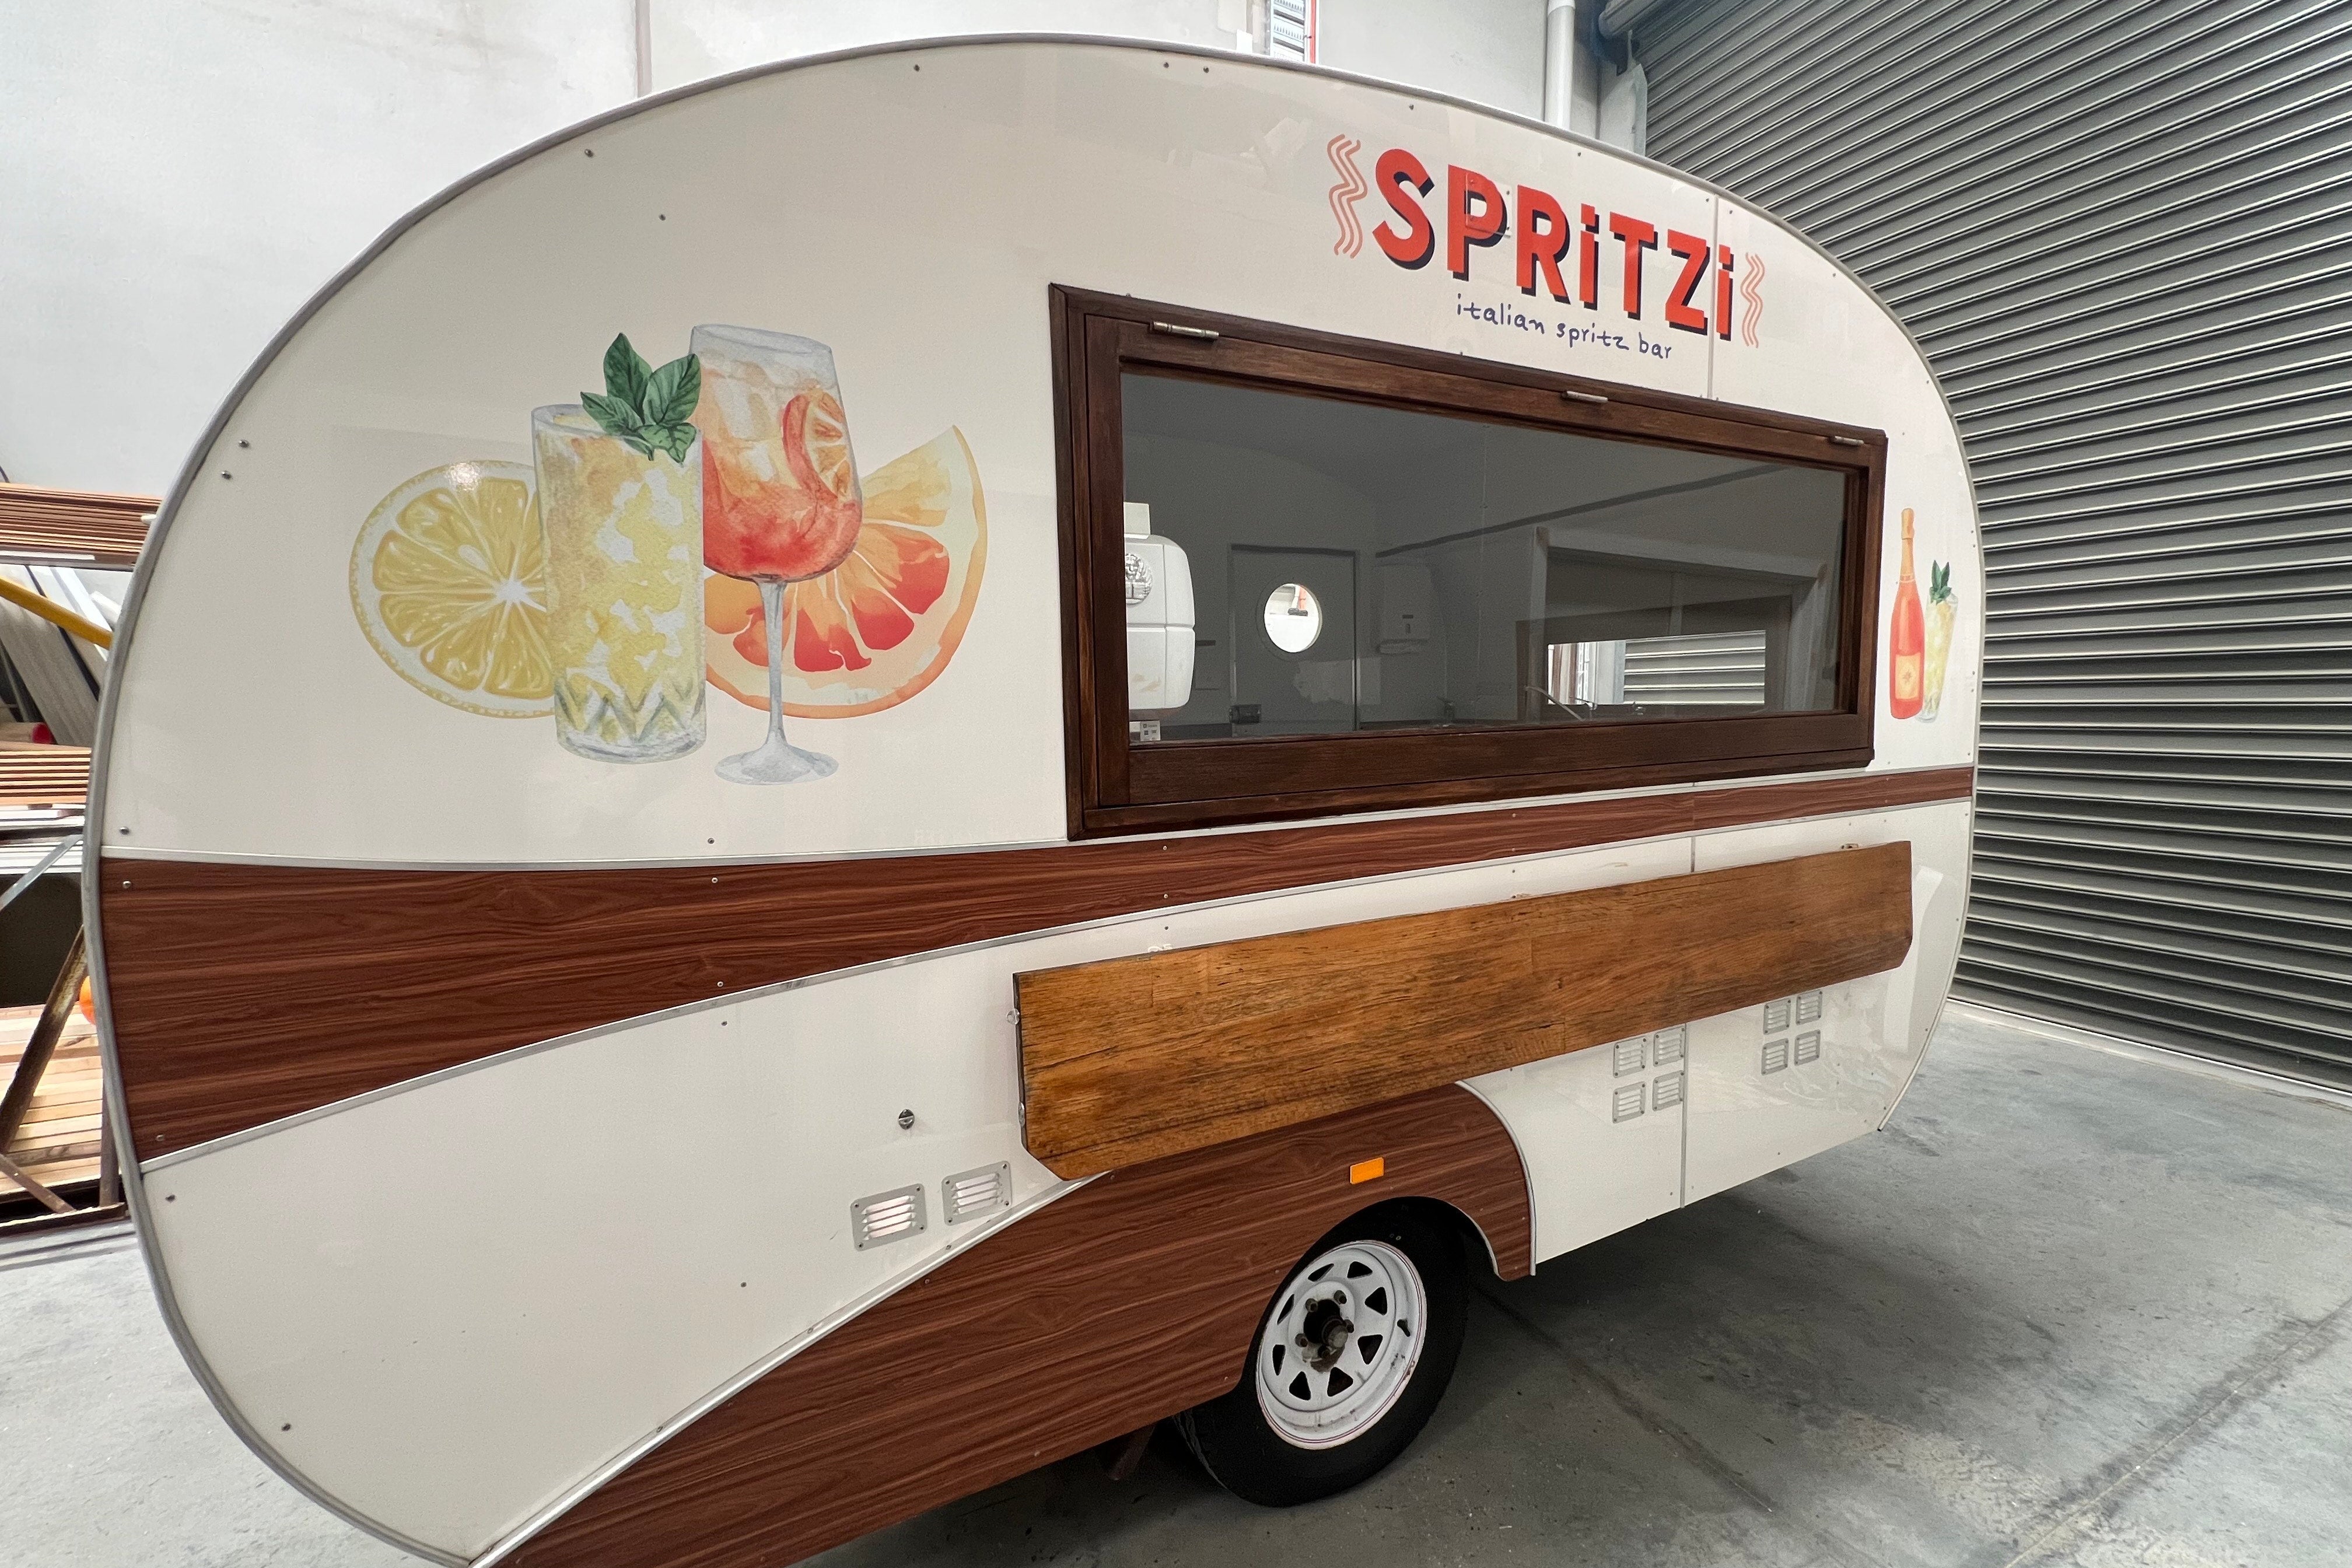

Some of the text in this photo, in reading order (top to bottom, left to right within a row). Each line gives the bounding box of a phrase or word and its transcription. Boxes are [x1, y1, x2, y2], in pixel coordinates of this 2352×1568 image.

[1372, 148, 1734, 341] SPRiTZi
[1457, 293, 1672, 359] italian spritz bar
